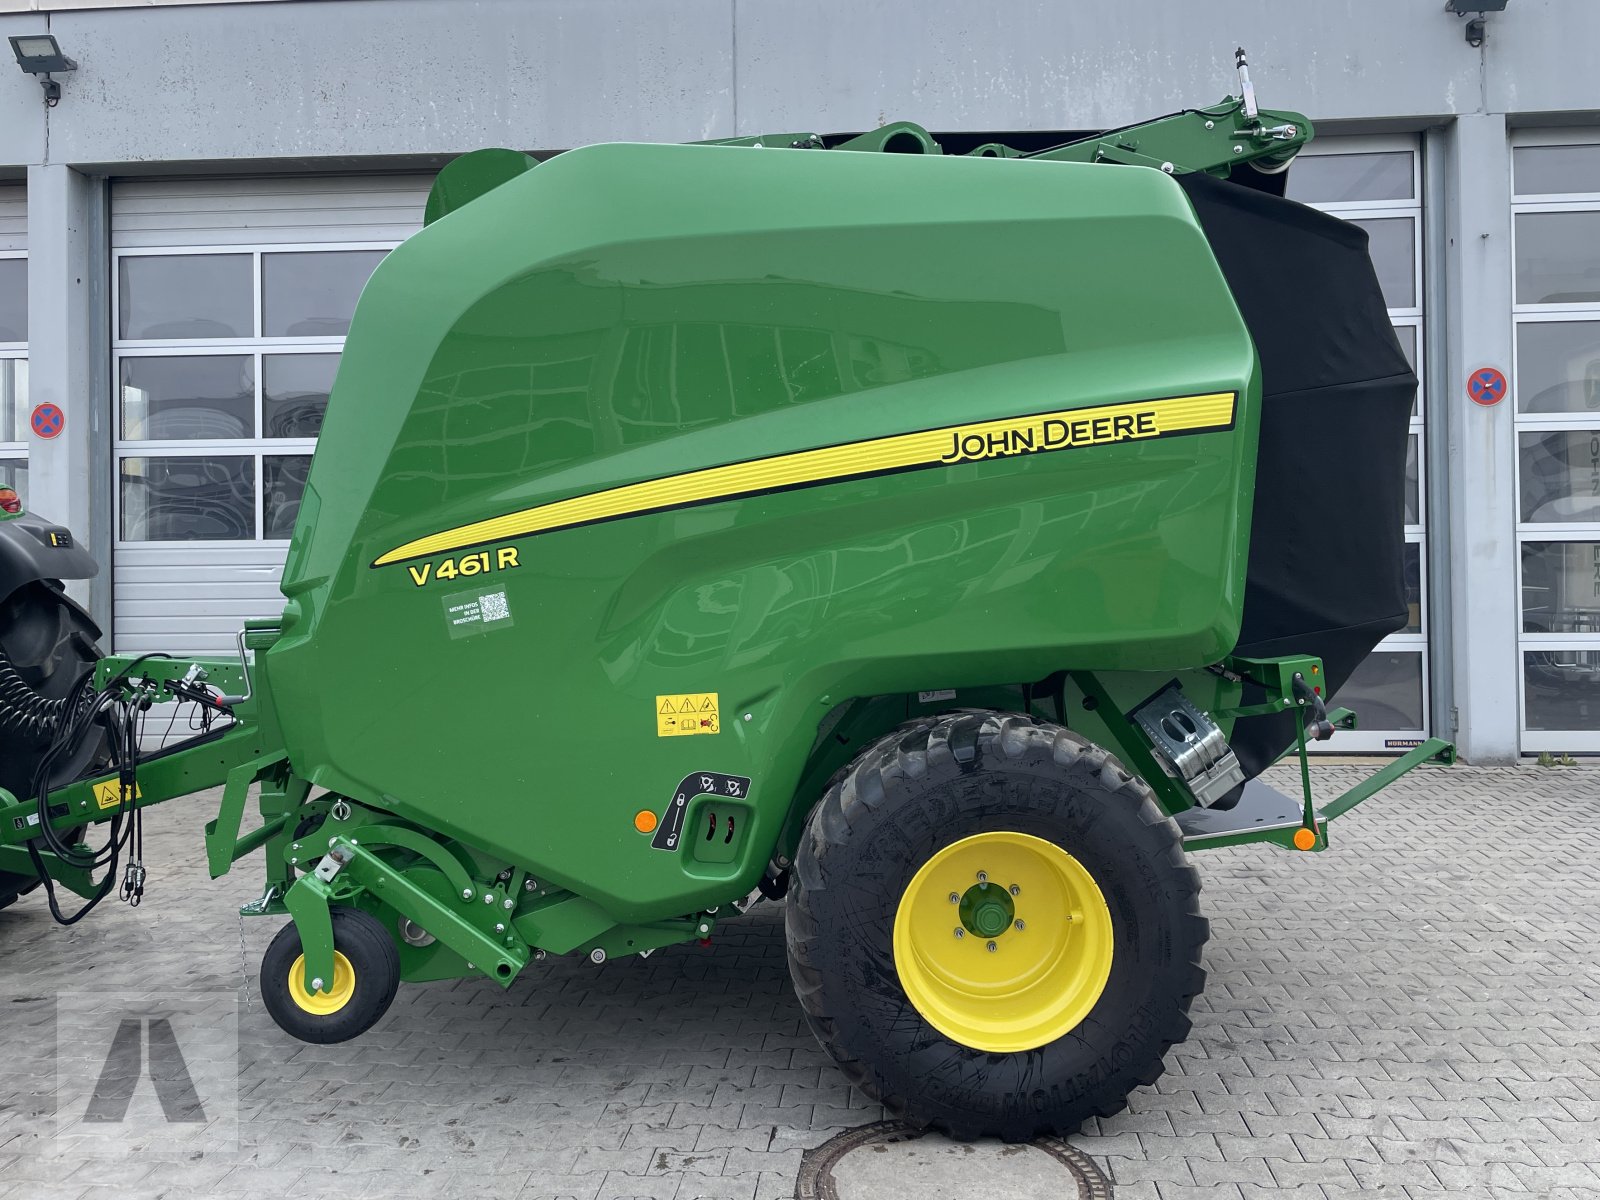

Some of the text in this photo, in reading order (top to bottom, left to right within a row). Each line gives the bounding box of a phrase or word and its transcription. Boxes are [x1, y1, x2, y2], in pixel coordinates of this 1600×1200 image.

[941, 411, 1156, 460] JOHN DEERE
[1589, 431, 1600, 497] OHN
[408, 547, 521, 586] V 461 R
